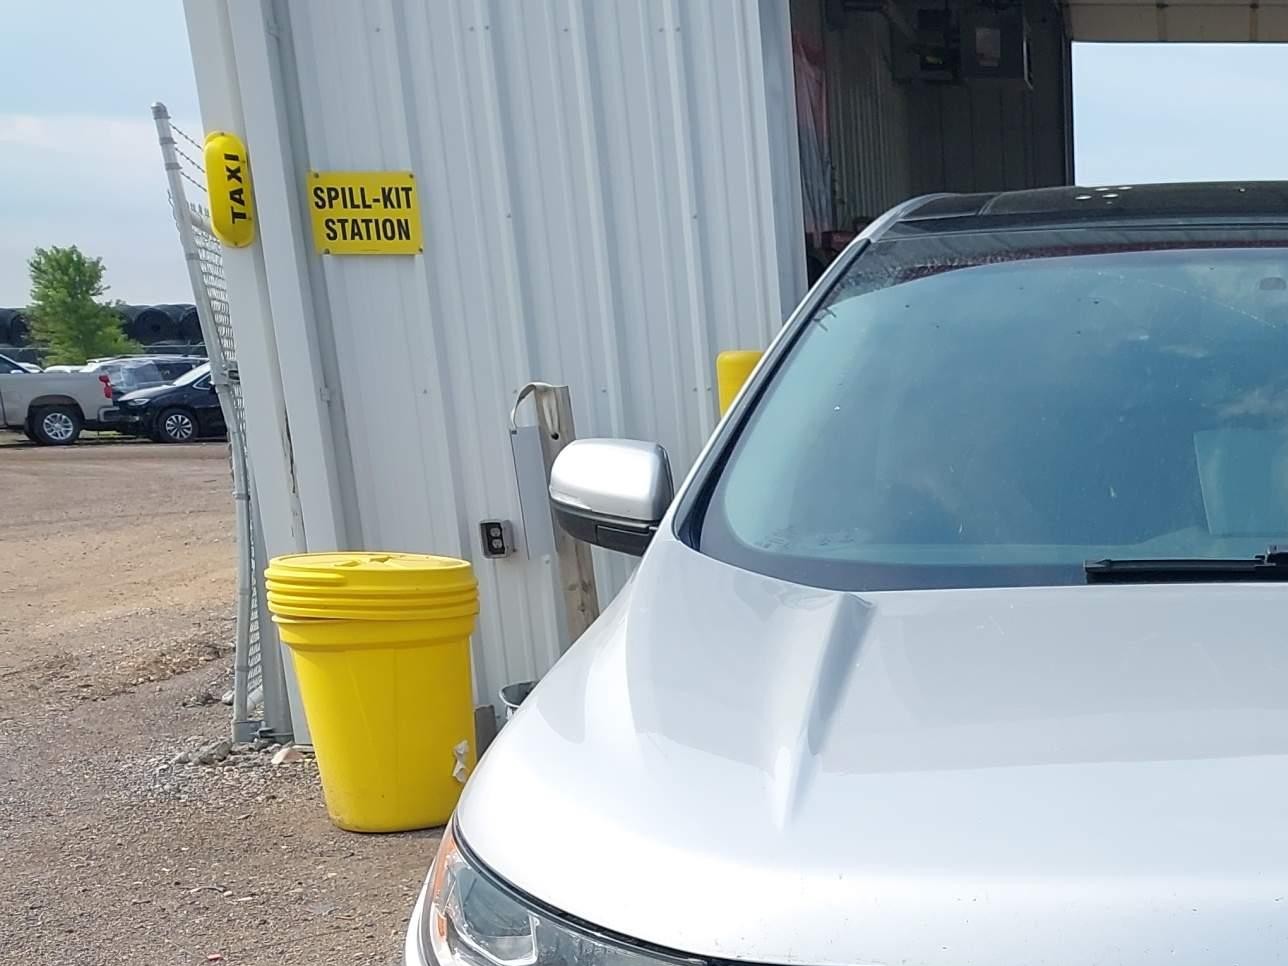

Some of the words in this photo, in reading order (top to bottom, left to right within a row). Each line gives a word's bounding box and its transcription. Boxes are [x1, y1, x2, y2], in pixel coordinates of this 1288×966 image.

[223, 152, 248, 225] TAXI
[313, 186, 413, 210] SPILL-KIT
[324, 218, 411, 241] STATION
